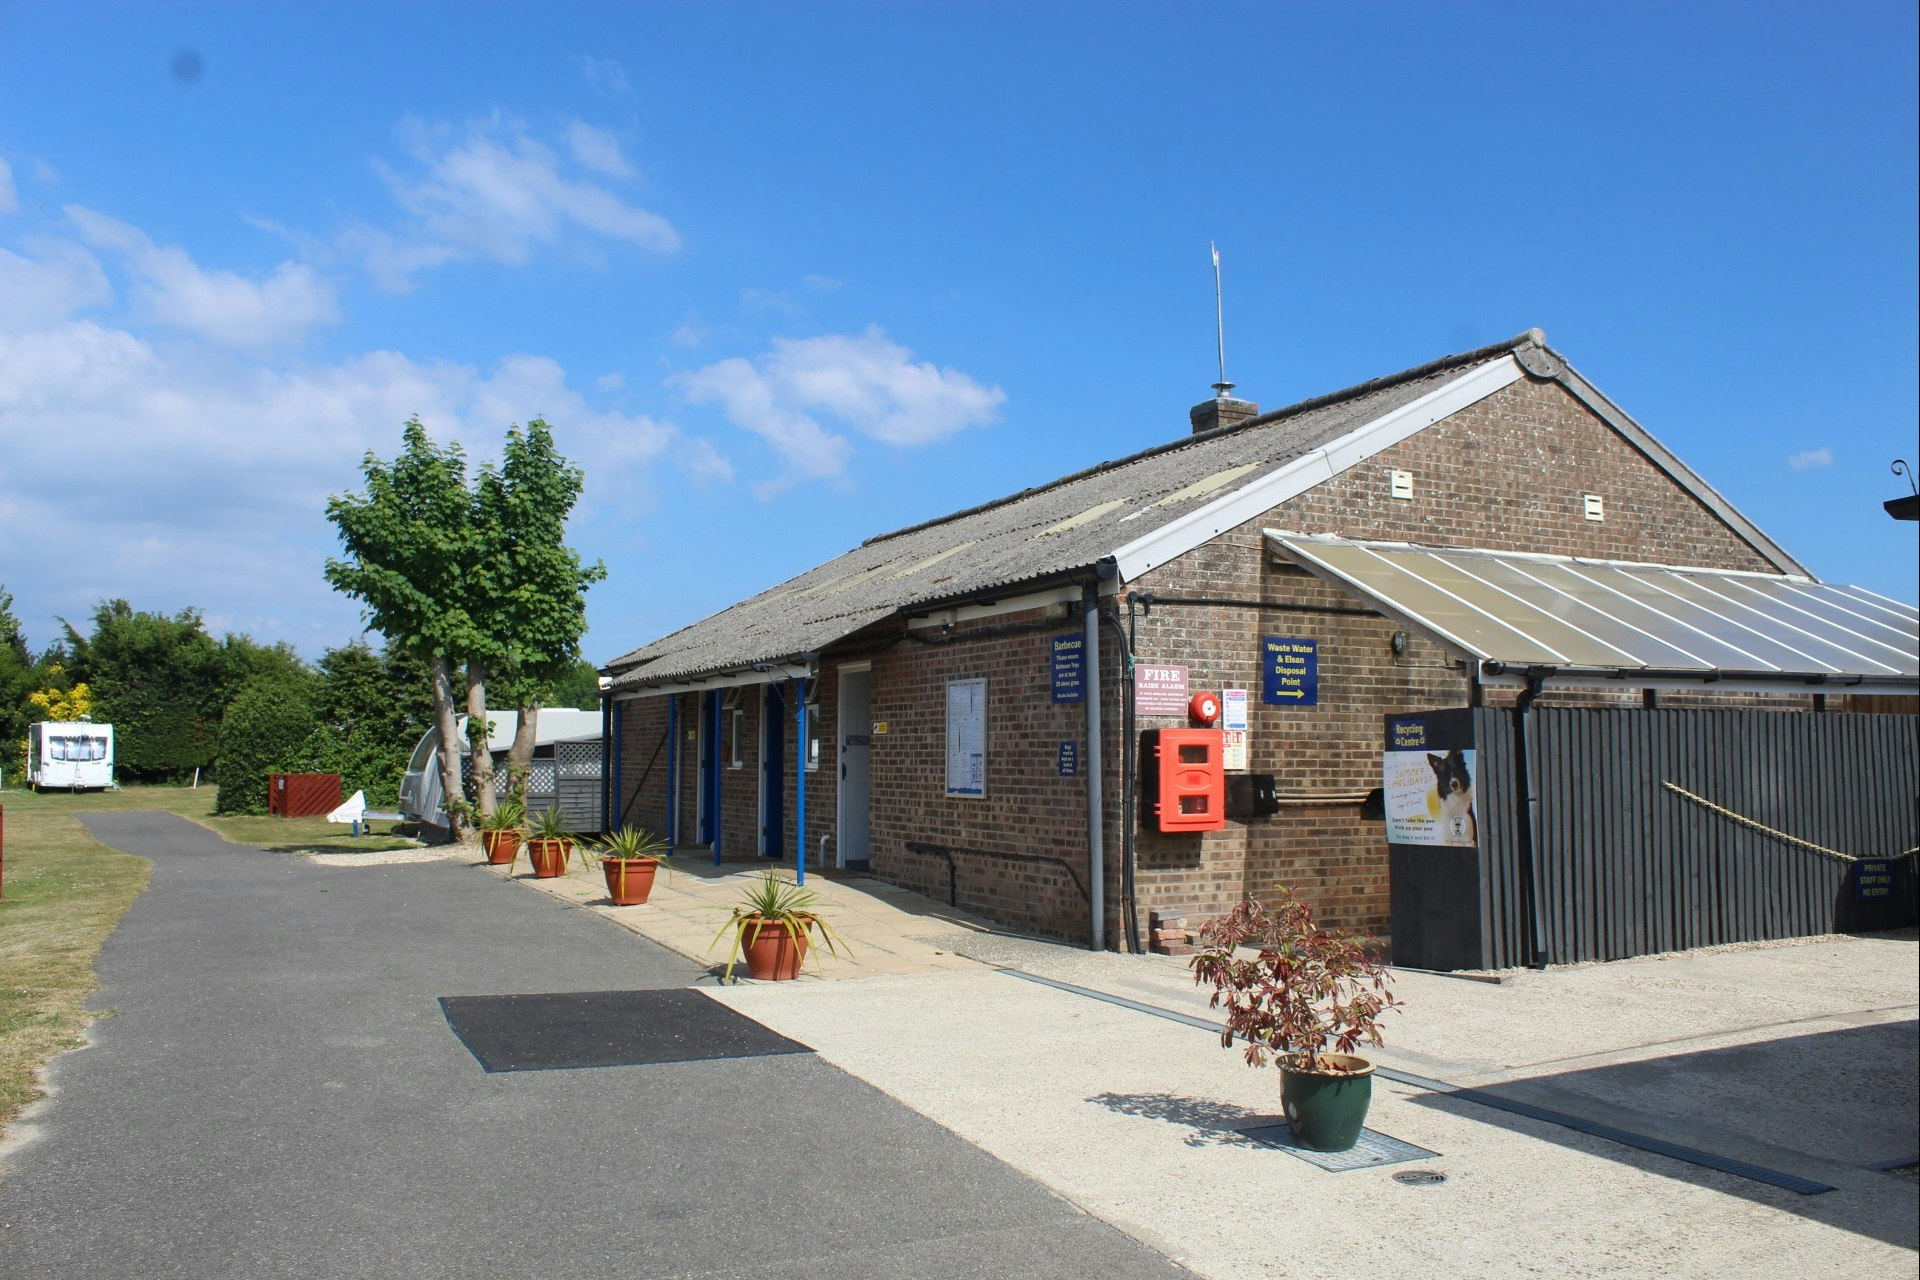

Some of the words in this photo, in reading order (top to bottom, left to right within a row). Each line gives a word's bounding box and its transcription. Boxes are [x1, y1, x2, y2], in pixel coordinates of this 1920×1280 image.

[1055, 641, 1081, 650] Barbecue
[1268, 643, 1290, 652] Waste
[1292, 644, 1313, 653] Water
[1277, 655, 1283, 663] &
[1285, 655, 1304, 664] Elsan
[1144, 669, 1180, 681] FIRE
[1276, 666, 1306, 676] Disposal
[1282, 678, 1300, 686] Point
[1395, 724, 1424, 735] Recycling
[1401, 737, 1419, 747] Centre
[1395, 767, 1426, 779] SUMMER
[1864, 864, 1887, 872] PRIVATE
[1860, 876, 1877, 884] STAFF
[1877, 876, 1890, 884] ONLY
[1862, 888, 1870, 896] NO
[1872, 888, 1889, 896] ENTRY
